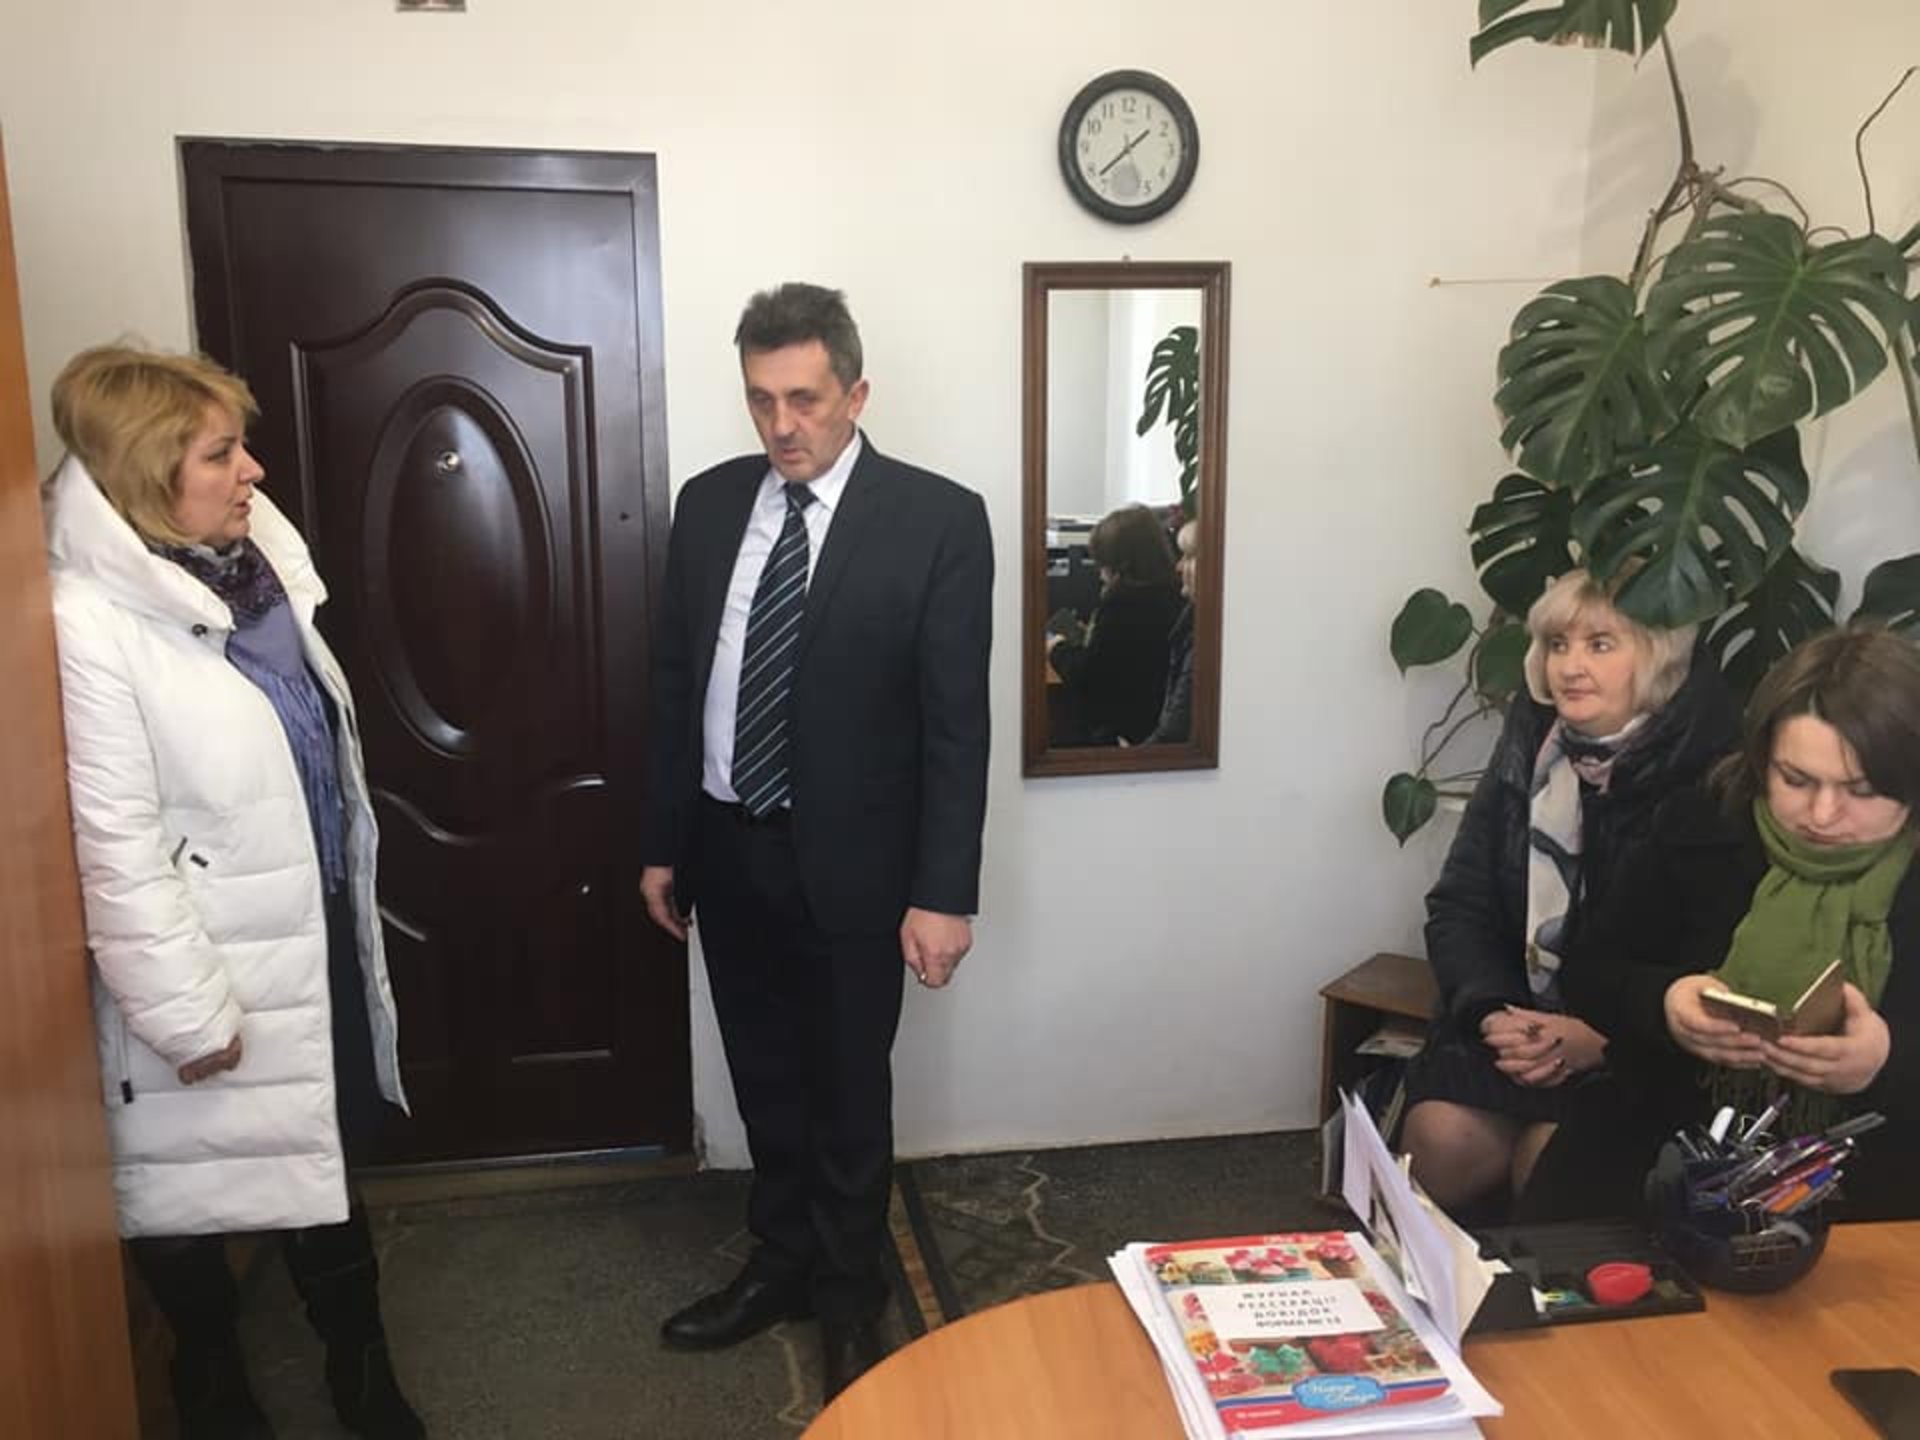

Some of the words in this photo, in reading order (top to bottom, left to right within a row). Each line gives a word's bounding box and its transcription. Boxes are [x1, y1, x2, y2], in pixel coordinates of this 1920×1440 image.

[1103, 103, 1115, 118] 11
[1121, 97, 1136, 113] 12
[1146, 104, 1152, 120] 1
[1086, 118, 1102, 136] 10
[1158, 121, 1169, 137] 2
[1143, 180, 1153, 195] 5
